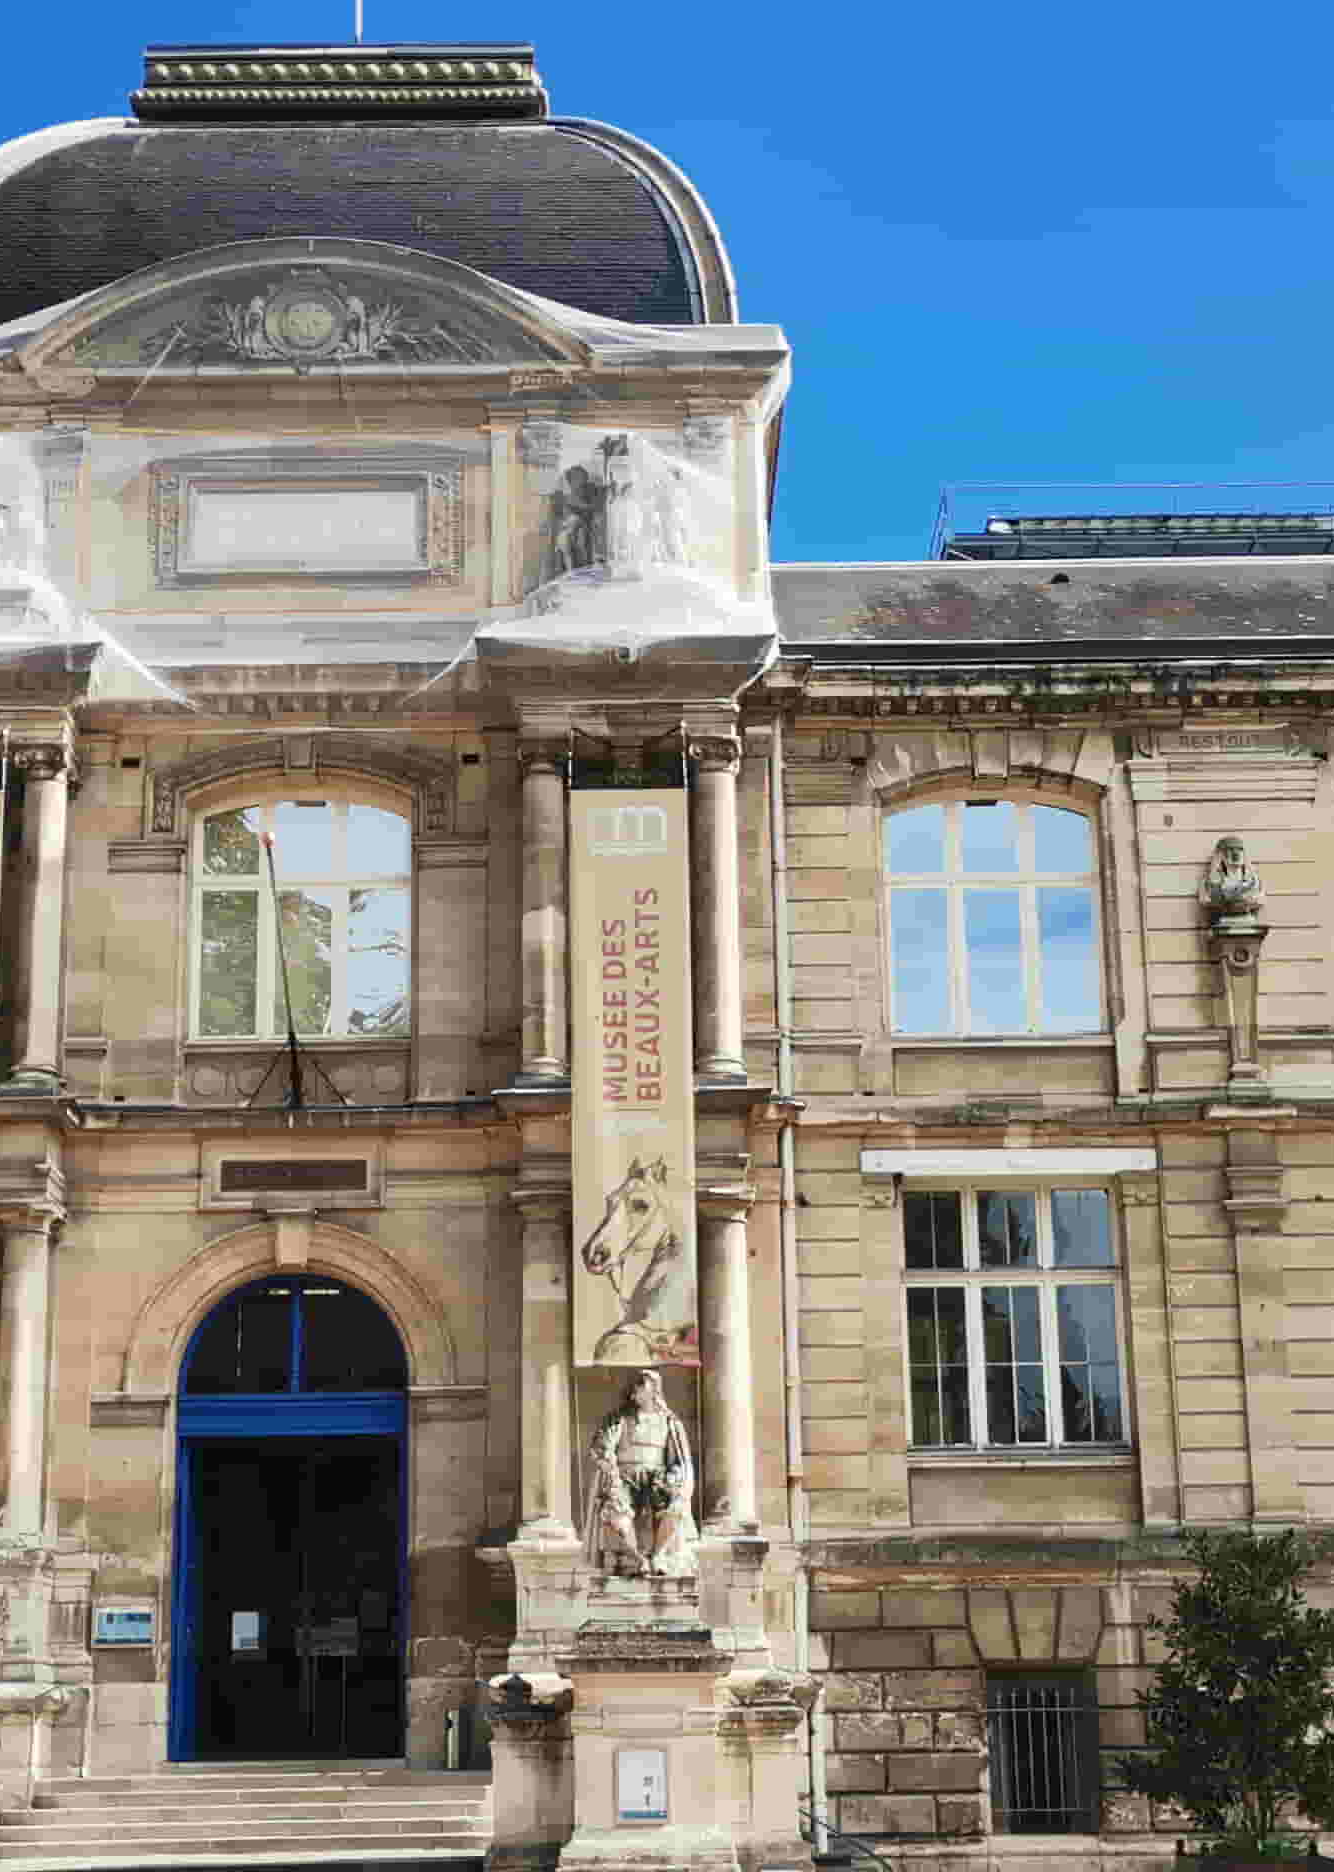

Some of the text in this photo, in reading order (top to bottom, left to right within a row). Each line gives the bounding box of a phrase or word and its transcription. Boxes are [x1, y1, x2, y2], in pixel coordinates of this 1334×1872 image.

[596, 920, 627, 1102] MUSÉE DES
[635, 888, 662, 1102] BEAUX-ARTS
